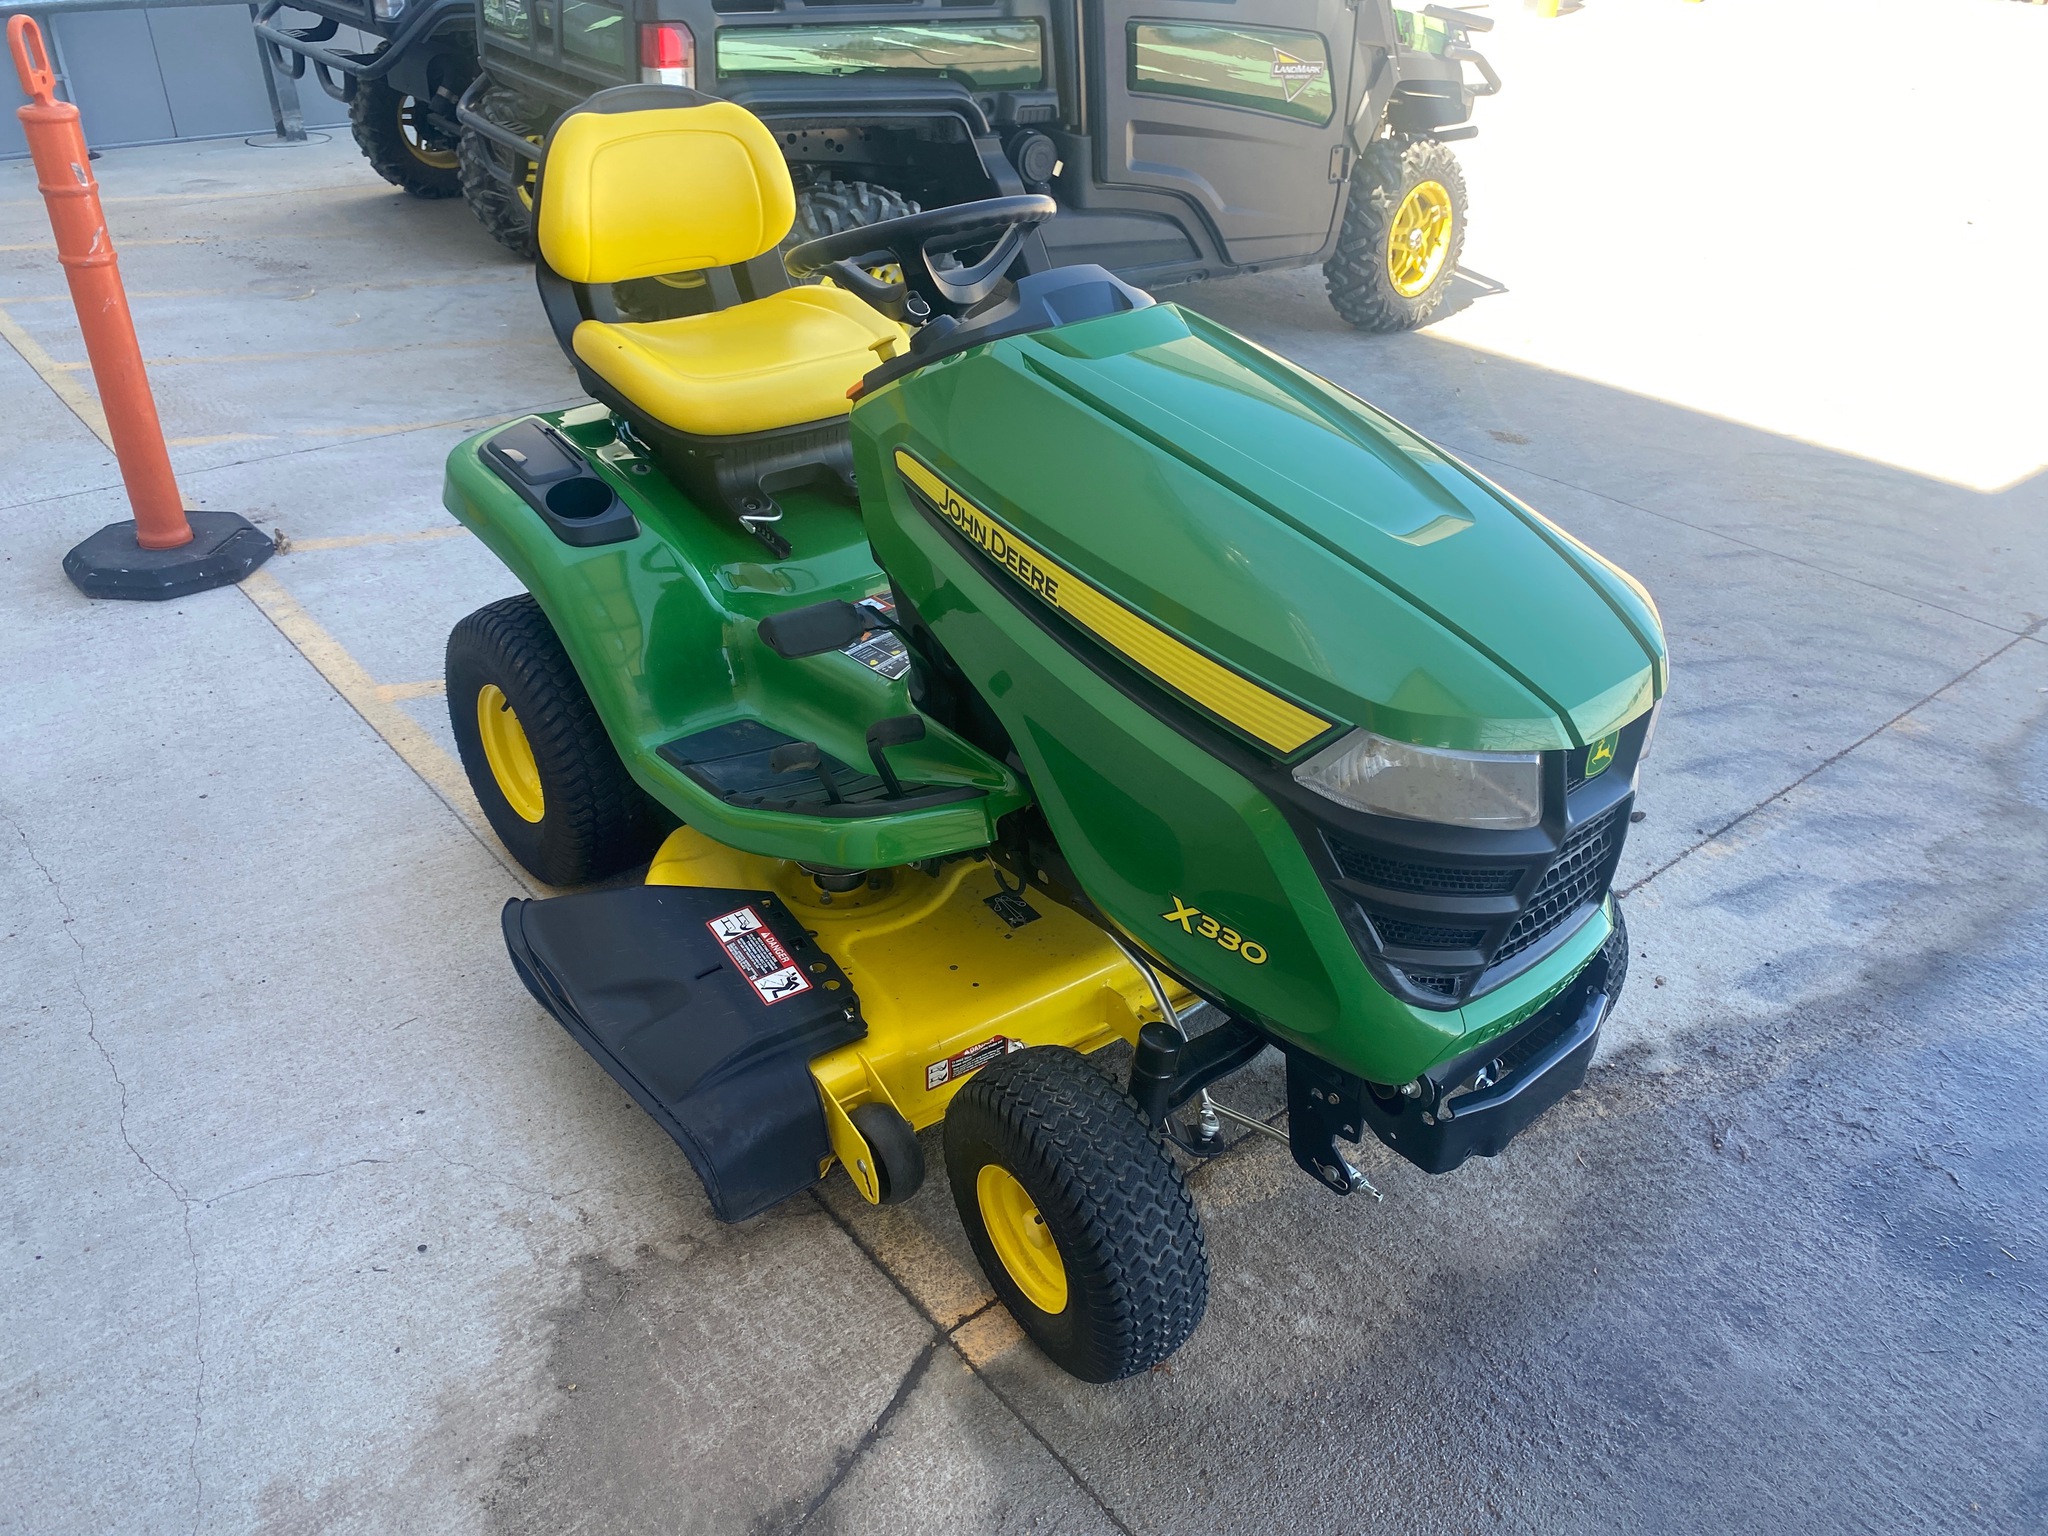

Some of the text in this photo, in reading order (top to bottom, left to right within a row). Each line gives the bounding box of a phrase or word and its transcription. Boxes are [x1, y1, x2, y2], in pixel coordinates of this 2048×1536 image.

[938, 487, 1059, 604] JOHN DEERE
[766, 936, 790, 963] DANGER
[1161, 894, 1269, 965] X330
